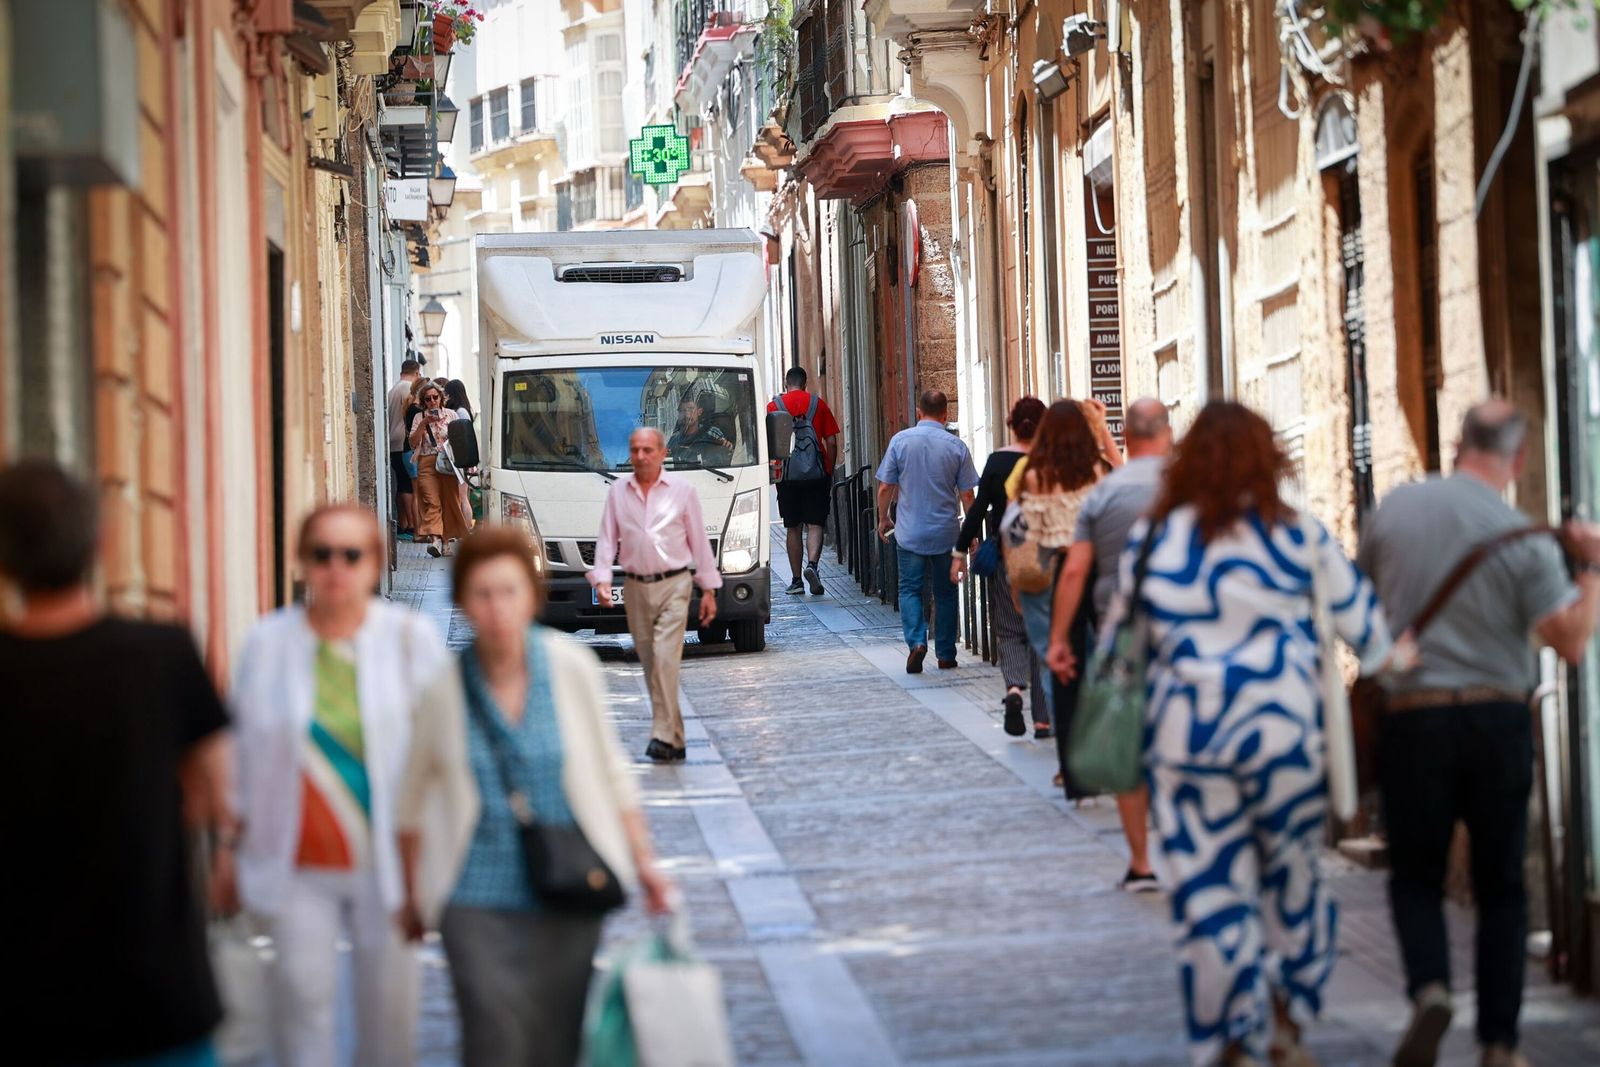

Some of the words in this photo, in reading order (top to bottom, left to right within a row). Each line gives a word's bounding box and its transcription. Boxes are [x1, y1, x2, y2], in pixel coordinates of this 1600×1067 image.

[1095, 304, 1119, 315] PORT
[600, 335, 654, 345] NISSAN
[1094, 393, 1121, 404] BASTI
